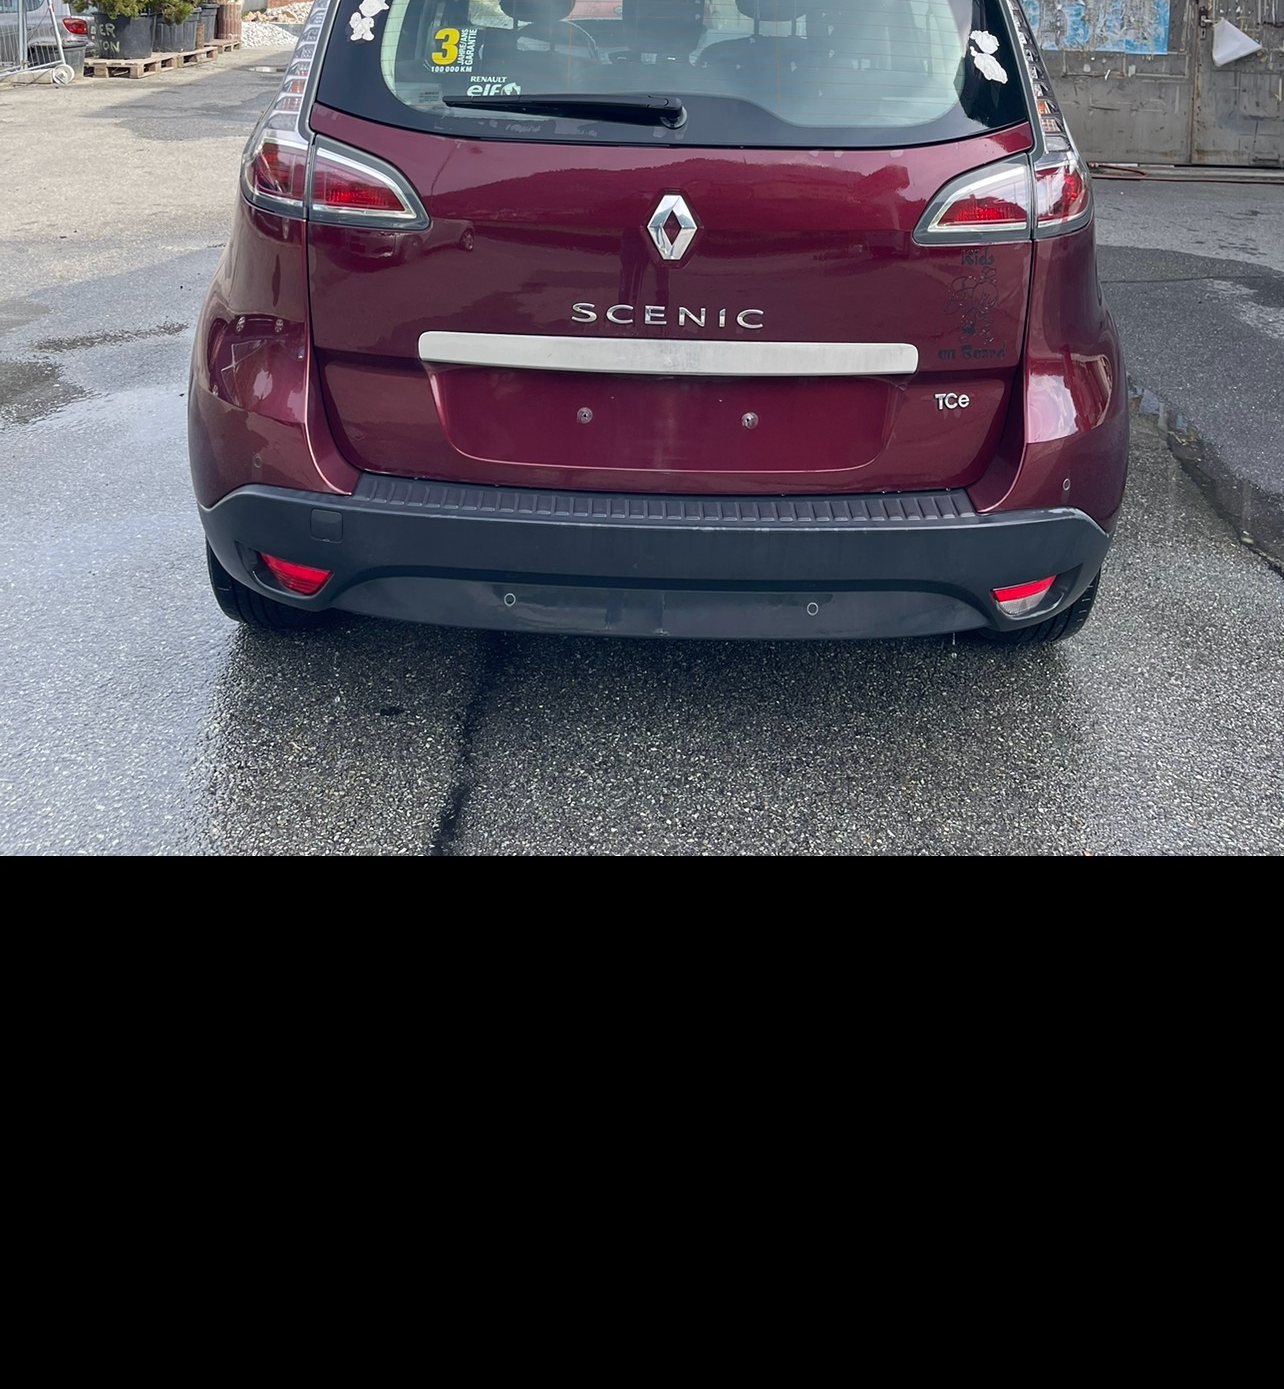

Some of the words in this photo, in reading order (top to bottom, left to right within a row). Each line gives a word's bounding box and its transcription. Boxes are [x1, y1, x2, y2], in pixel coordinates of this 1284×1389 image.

[431, 27, 460, 65] 3
[457, 28, 469, 65] JAHRE/ANS
[464, 28, 477, 66] GARANTIE
[466, 83, 502, 97] elf
[961, 249, 995, 266] Kids
[571, 302, 764, 329] SCENIC
[934, 393, 970, 410] TCe
